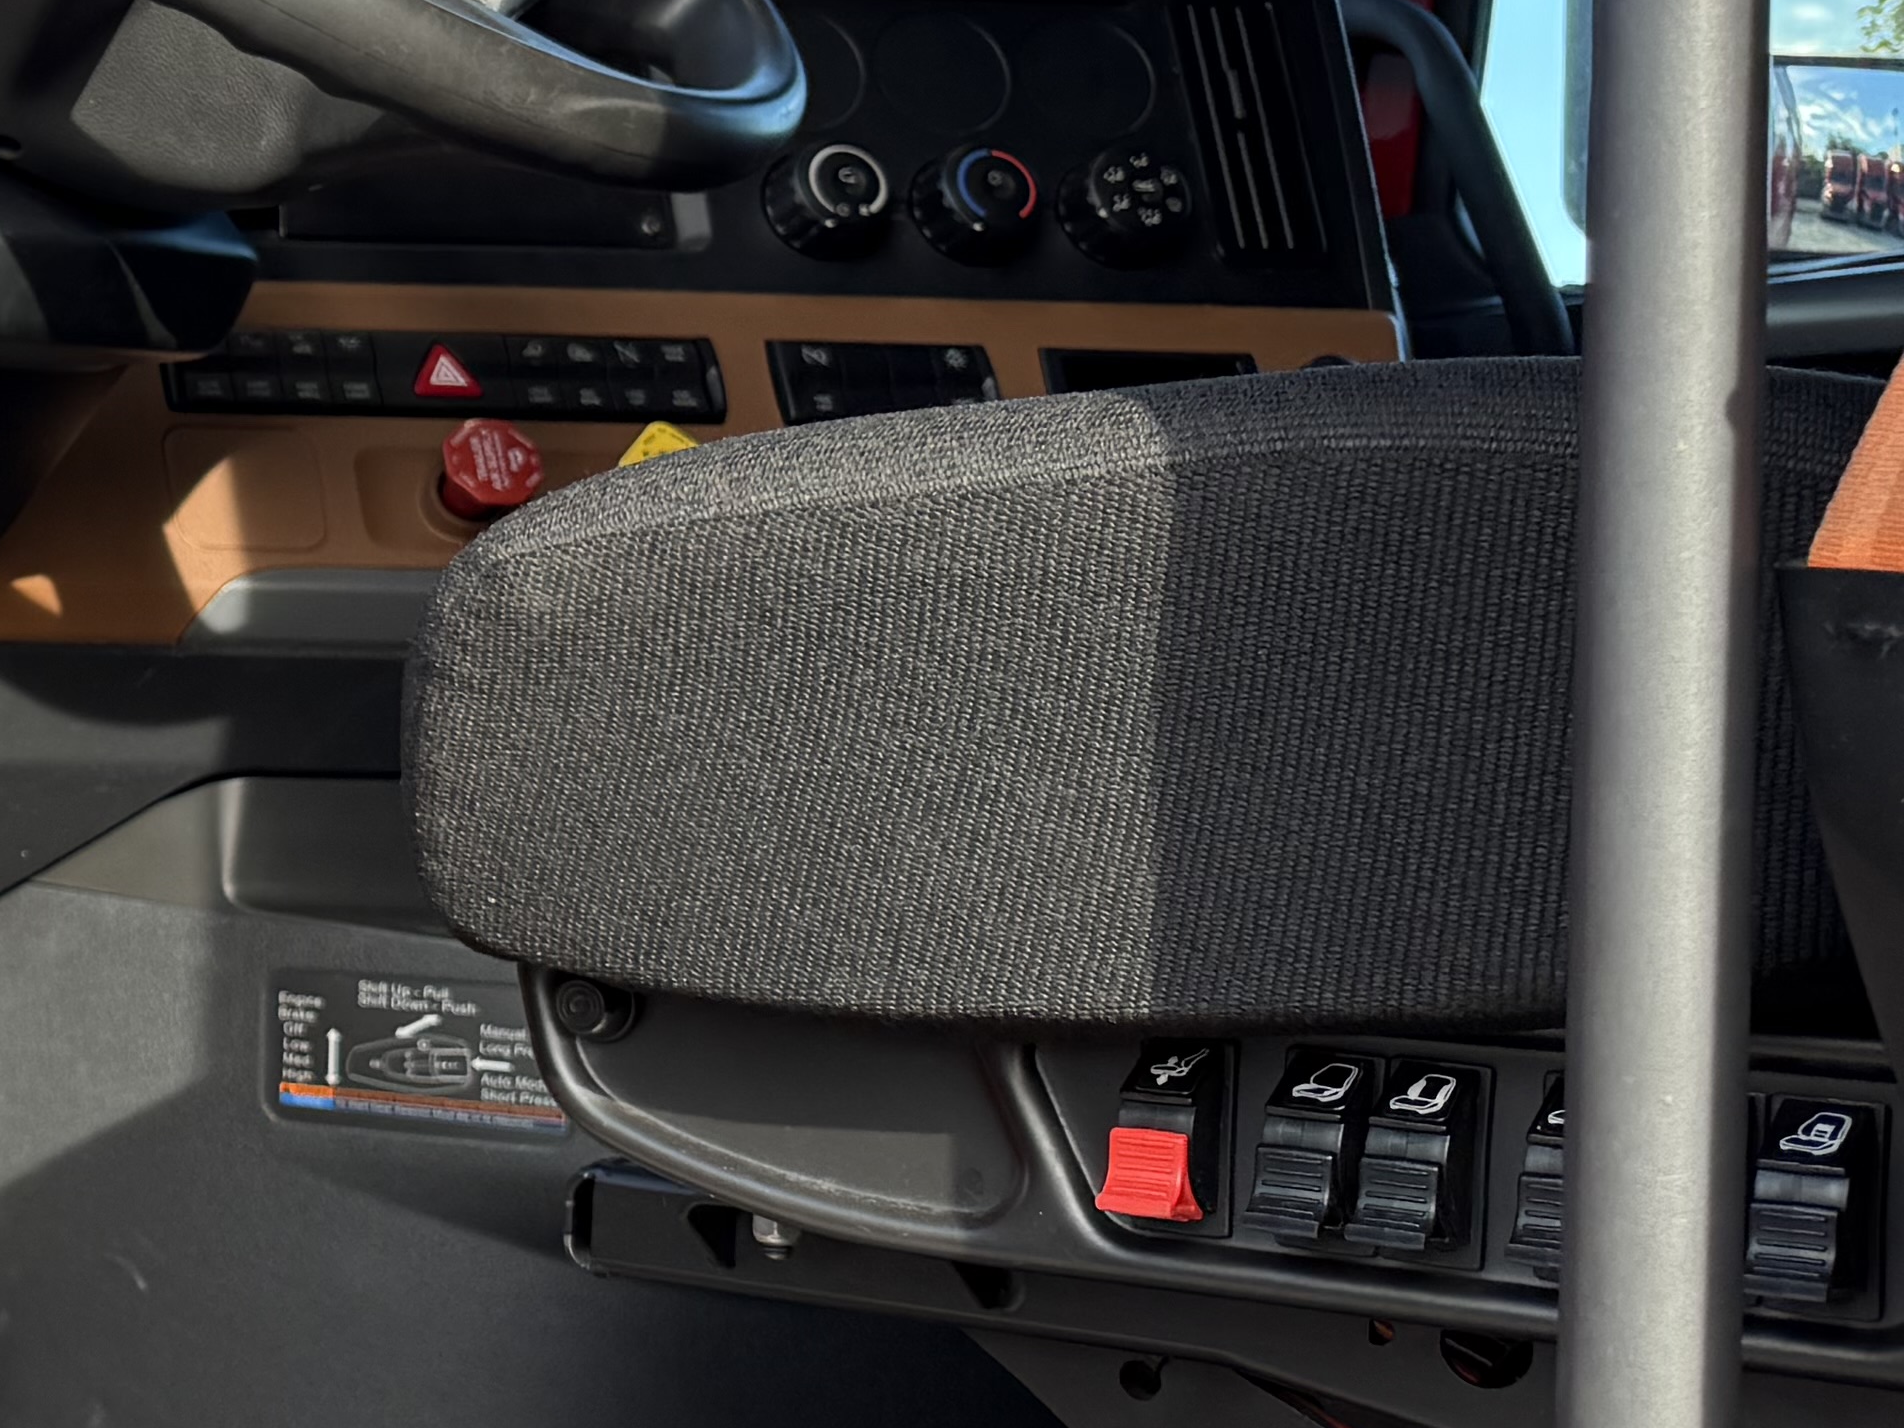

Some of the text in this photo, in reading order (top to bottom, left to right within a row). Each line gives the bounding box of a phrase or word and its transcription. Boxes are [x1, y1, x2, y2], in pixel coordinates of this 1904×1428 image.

[358, 979, 388, 993] Shift
[391, 983, 411, 999] Up
[423, 985, 449, 1001] Pull
[278, 990, 323, 1009] Engine
[358, 992, 387, 1008] Shift
[391, 995, 429, 1012] Down
[442, 999, 476, 1016] Push
[278, 1005, 317, 1022] Brake
[479, 1023, 526, 1040] Manual
[283, 1037, 310, 1052] Low
[479, 1040, 511, 1058] Long
[283, 1052, 311, 1067] Med
[481, 1072, 512, 1089] Auto
[481, 1087, 515, 1103] Short
